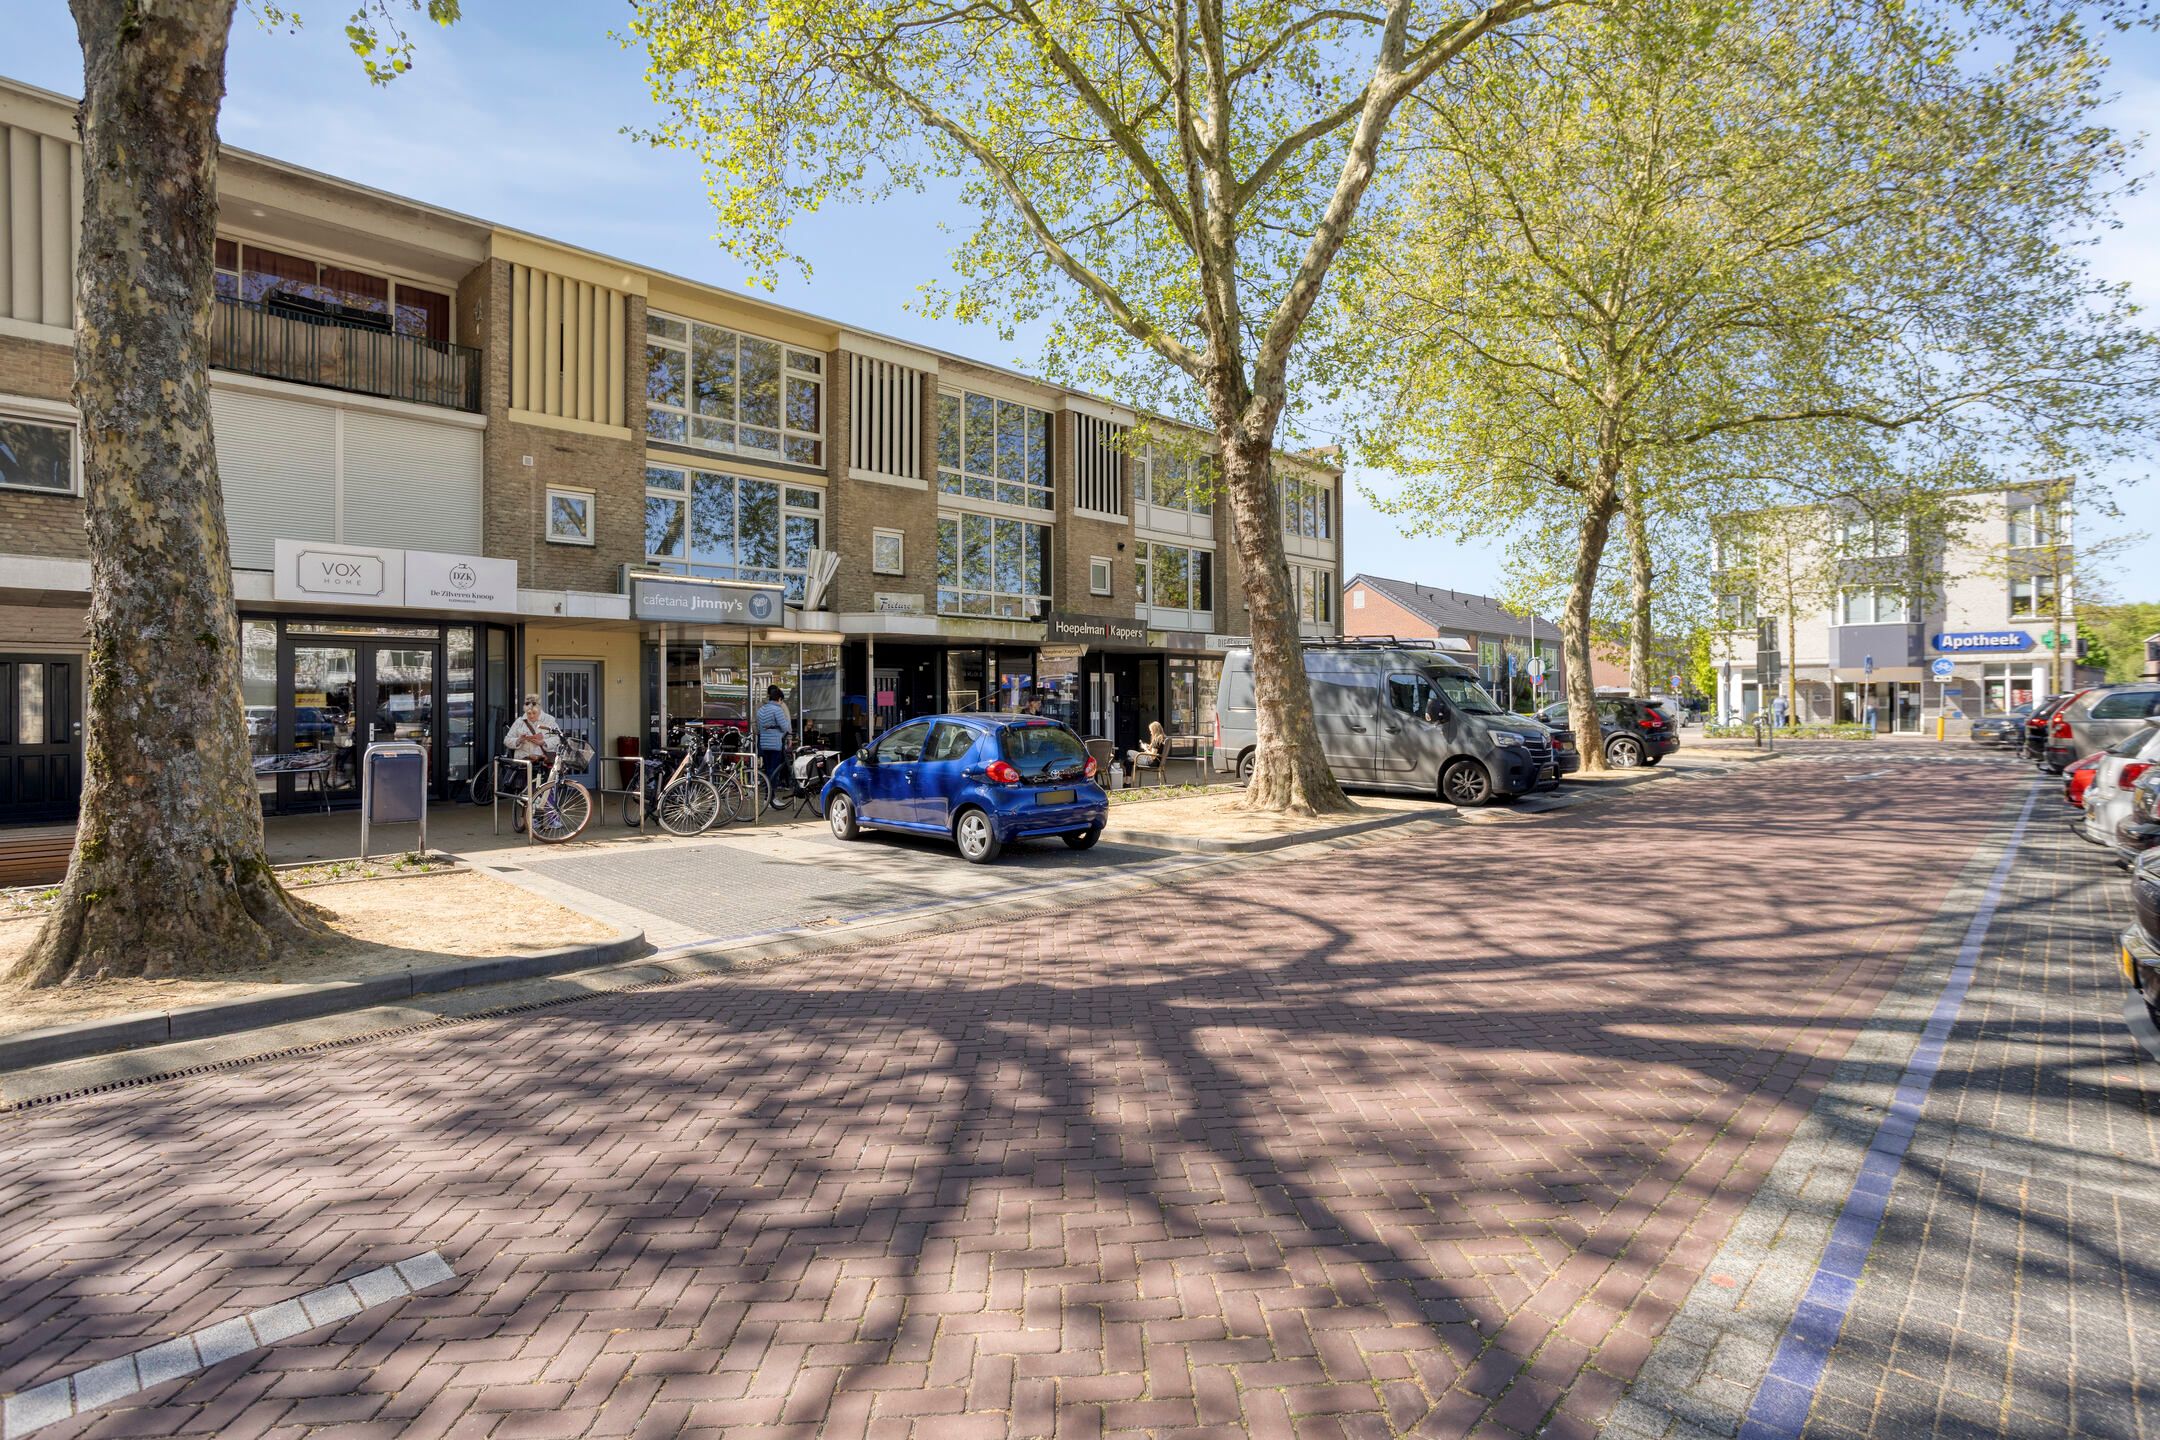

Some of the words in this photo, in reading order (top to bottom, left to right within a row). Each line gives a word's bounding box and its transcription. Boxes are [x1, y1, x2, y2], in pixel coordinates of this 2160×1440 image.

[321, 562, 361, 578] VOX
[453, 572, 472, 581] DZK
[323, 578, 362, 586] HOME
[642, 593, 689, 608] cafetaria
[690, 595, 743, 614] Jimmy's
[1055, 621, 1105, 637] Hoepelman
[1109, 624, 1143, 640] Kappers
[1942, 633, 2020, 649] Apotheek
